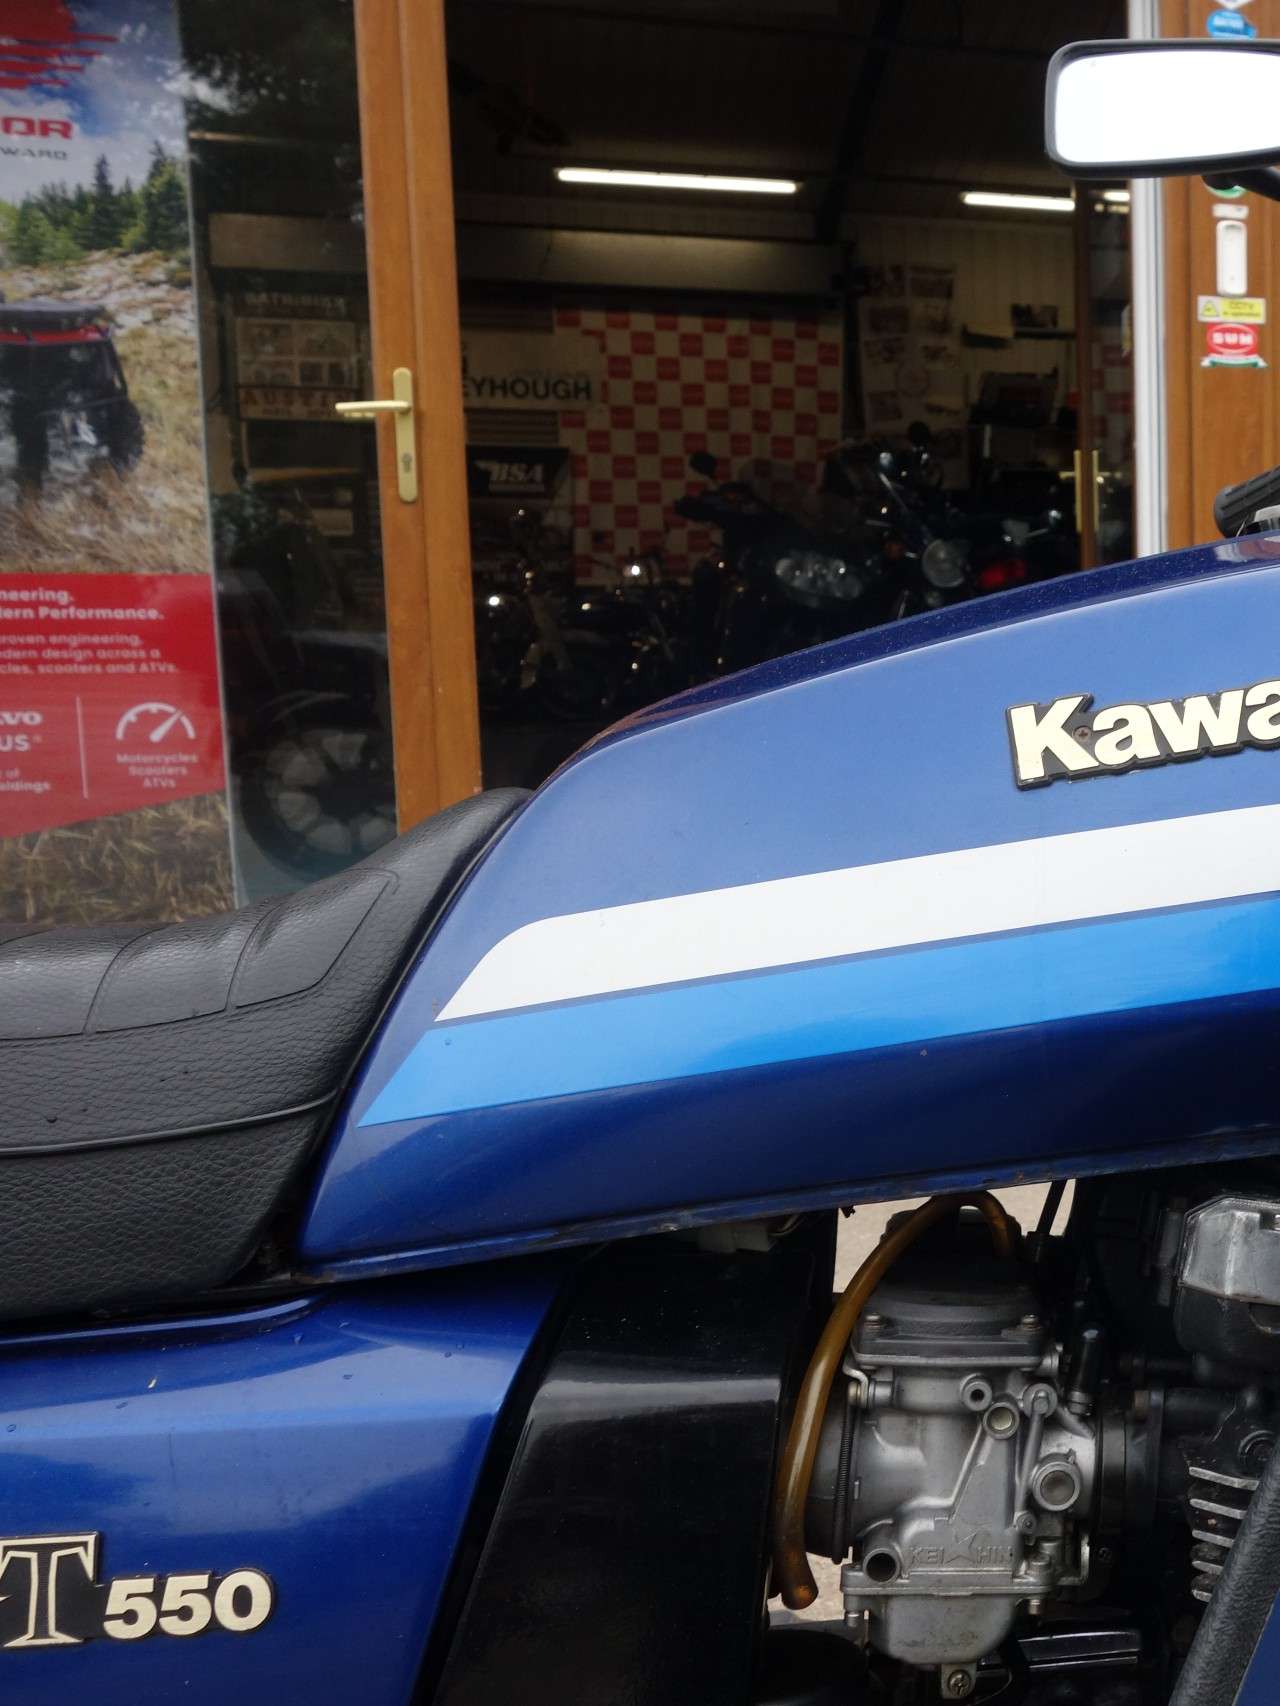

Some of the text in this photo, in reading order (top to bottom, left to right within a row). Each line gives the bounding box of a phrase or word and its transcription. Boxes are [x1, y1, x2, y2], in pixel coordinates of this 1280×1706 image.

[0, 605, 164, 620] ern Performance.
[0, 1532, 273, 1648] T 550
